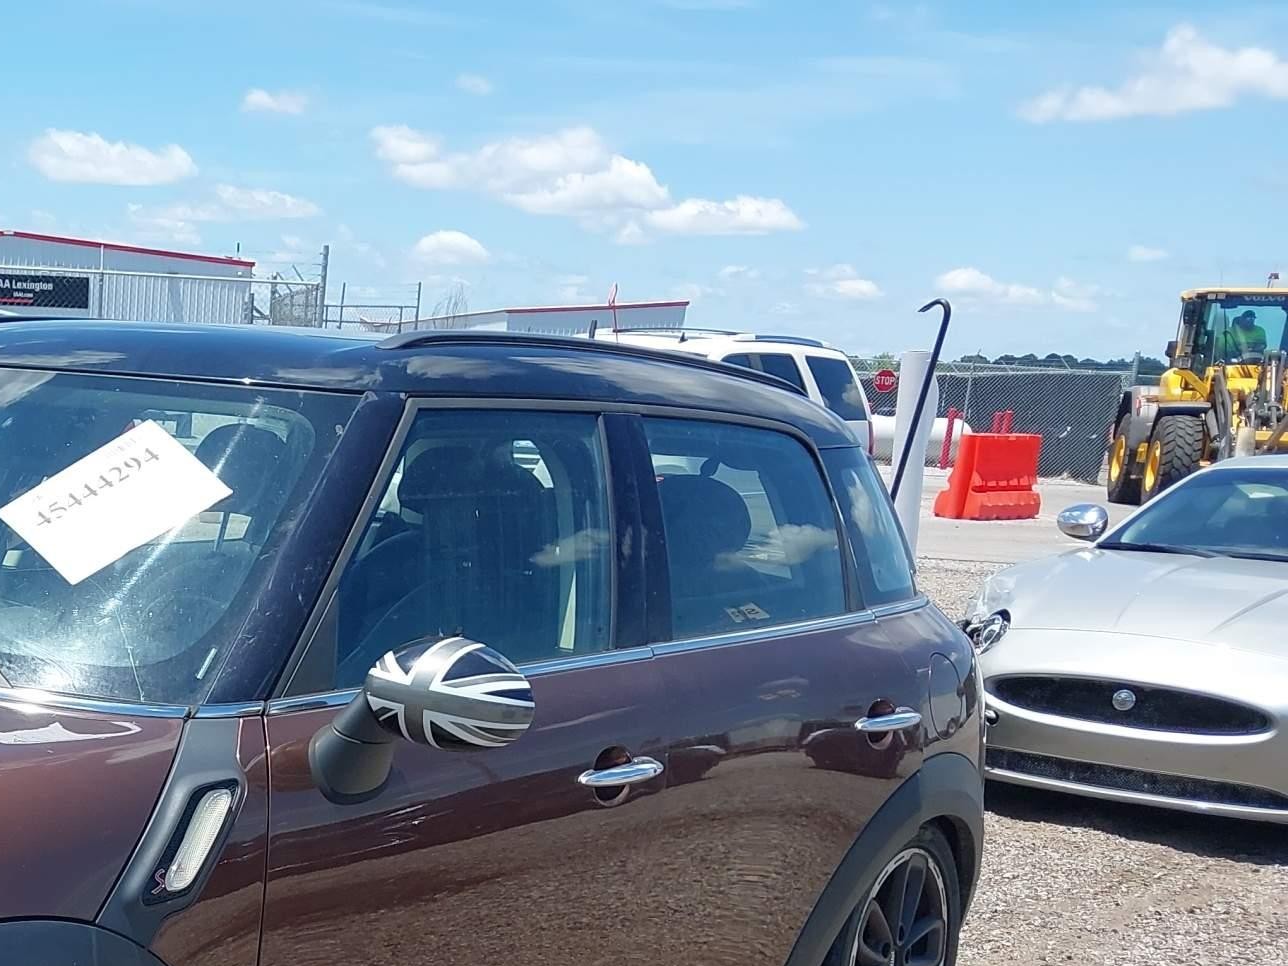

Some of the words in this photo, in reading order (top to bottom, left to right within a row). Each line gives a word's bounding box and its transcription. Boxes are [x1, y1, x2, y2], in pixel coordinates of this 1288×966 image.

[12, 279, 53, 291] Lexington
[875, 375, 895, 386] STOP
[36, 447, 160, 527] 45444294
